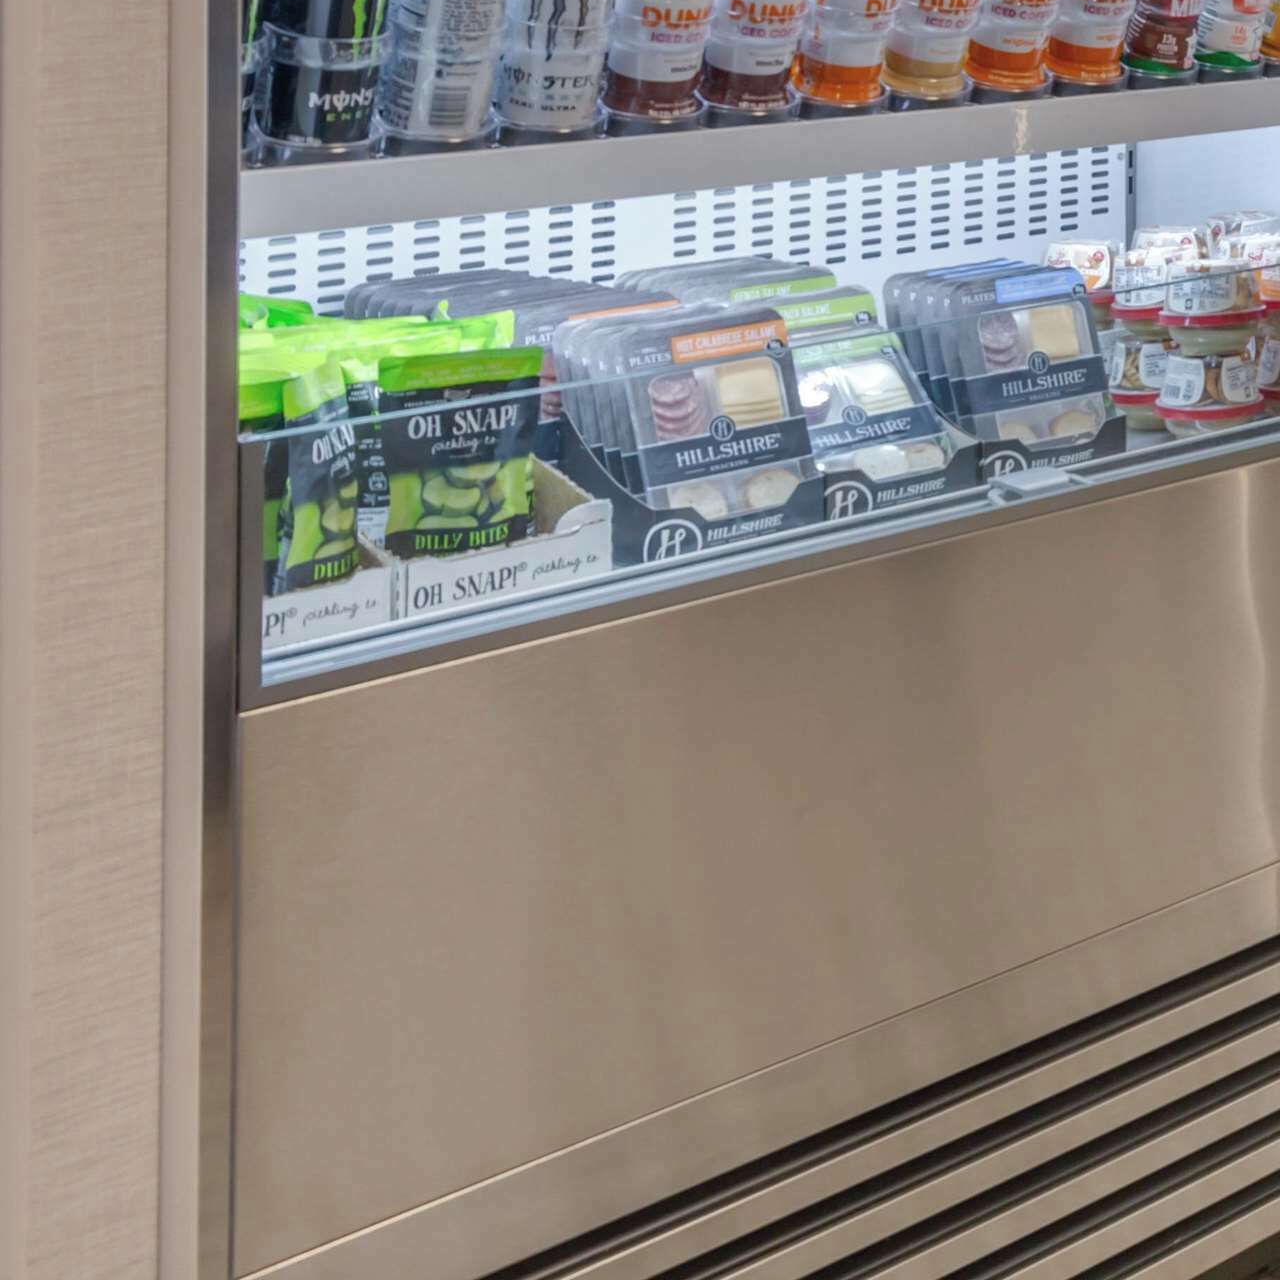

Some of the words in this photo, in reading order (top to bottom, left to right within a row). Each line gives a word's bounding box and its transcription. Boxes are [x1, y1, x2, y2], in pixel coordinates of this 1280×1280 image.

[961, 292, 995, 305] PLATES
[629, 350, 672, 368] PLATES
[1002, 369, 1086, 397] HILLSHIRE
[408, 415, 442, 440] OH
[452, 404, 520, 436] SNAP!
[816, 418, 911, 447] HILLSHIRE
[676, 433, 780, 468] HILLSHIRE
[876, 477, 946, 503] HILLSHIRE
[416, 533, 462, 550] DILLY
[469, 523, 510, 545] BITES
[707, 514, 784, 542] HILLSHIRE
[413, 582, 443, 610] OH
